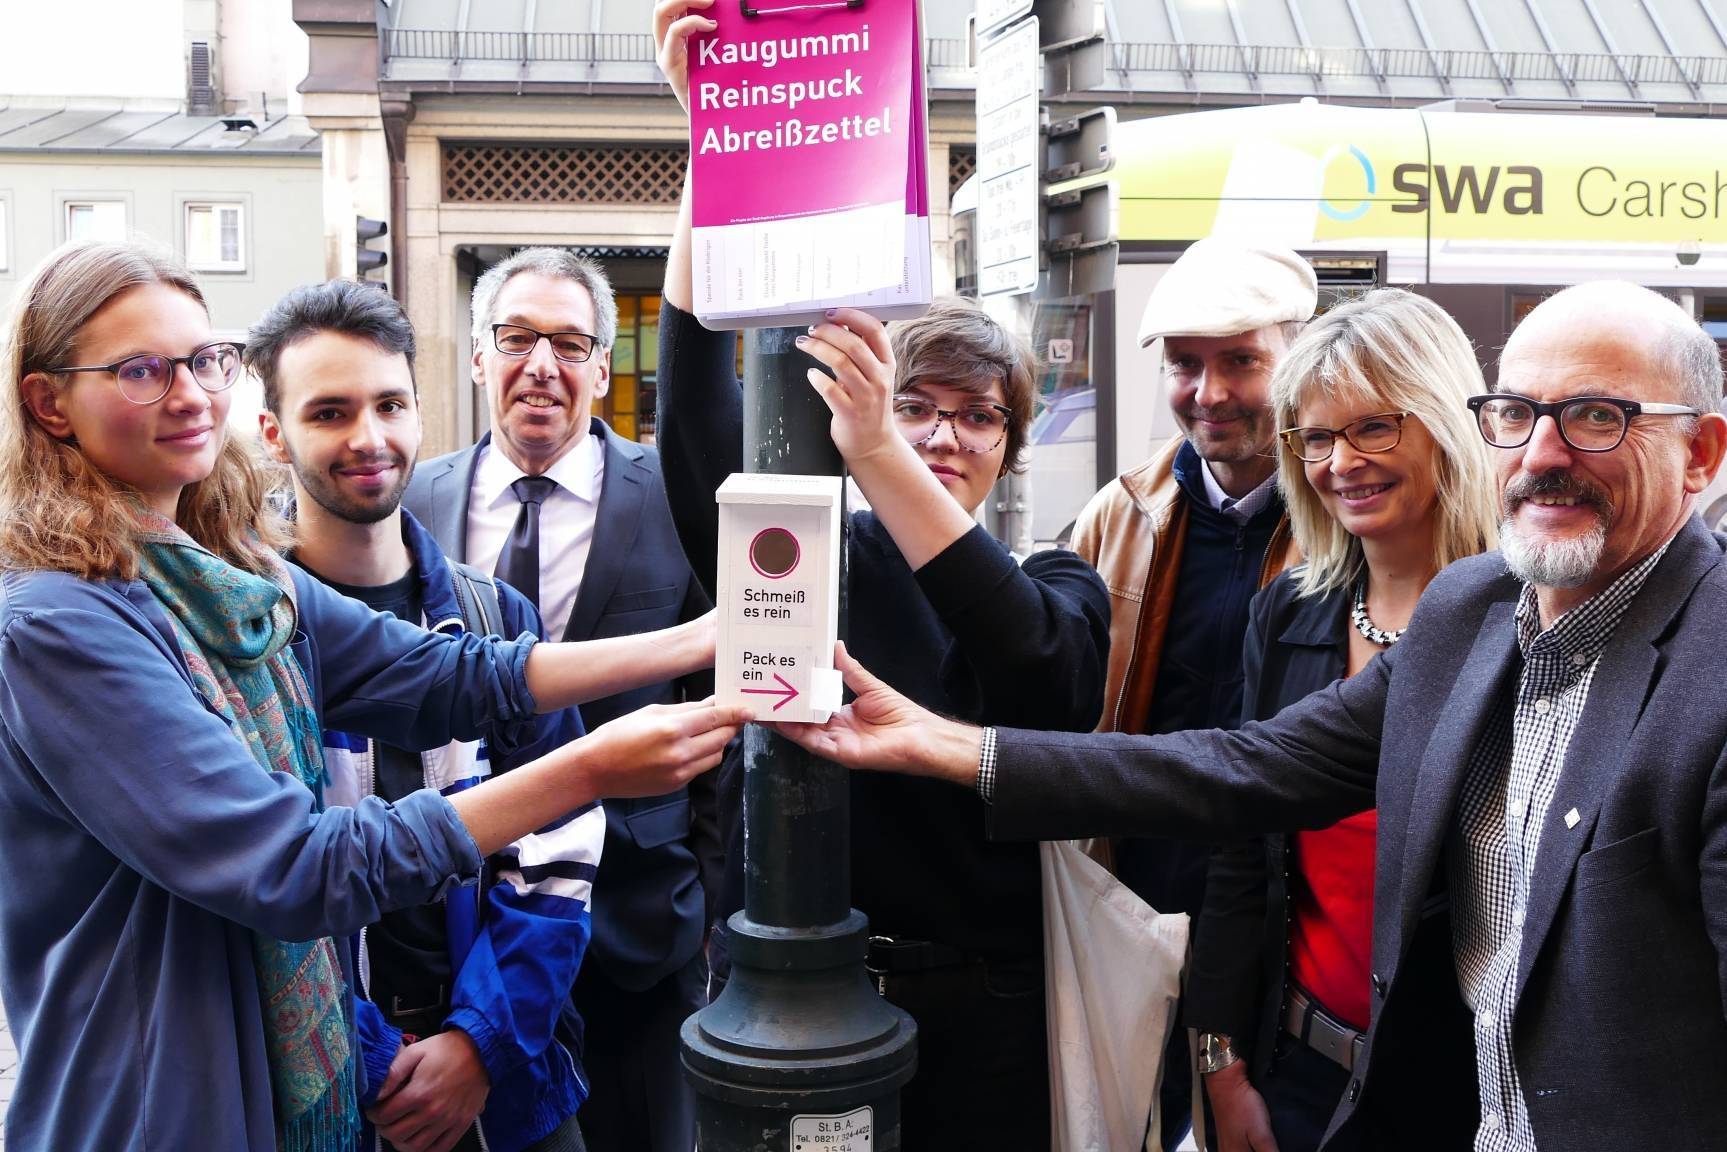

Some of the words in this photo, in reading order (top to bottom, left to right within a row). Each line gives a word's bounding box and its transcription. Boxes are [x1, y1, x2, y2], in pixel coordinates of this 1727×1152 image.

[699, 25, 869, 67] Kaugummi
[700, 69, 862, 110] Reinspuck
[699, 107, 892, 155] Abreißzettel
[1391, 162, 1544, 215] swa
[744, 588, 805, 604] Schmeiß
[743, 606, 760, 618] es
[763, 606, 791, 619] rein
[743, 652, 775, 667] Pack
[779, 654, 796, 666] es
[742, 668, 763, 681] ein
[796, 1135, 811, 1143] Tel.
